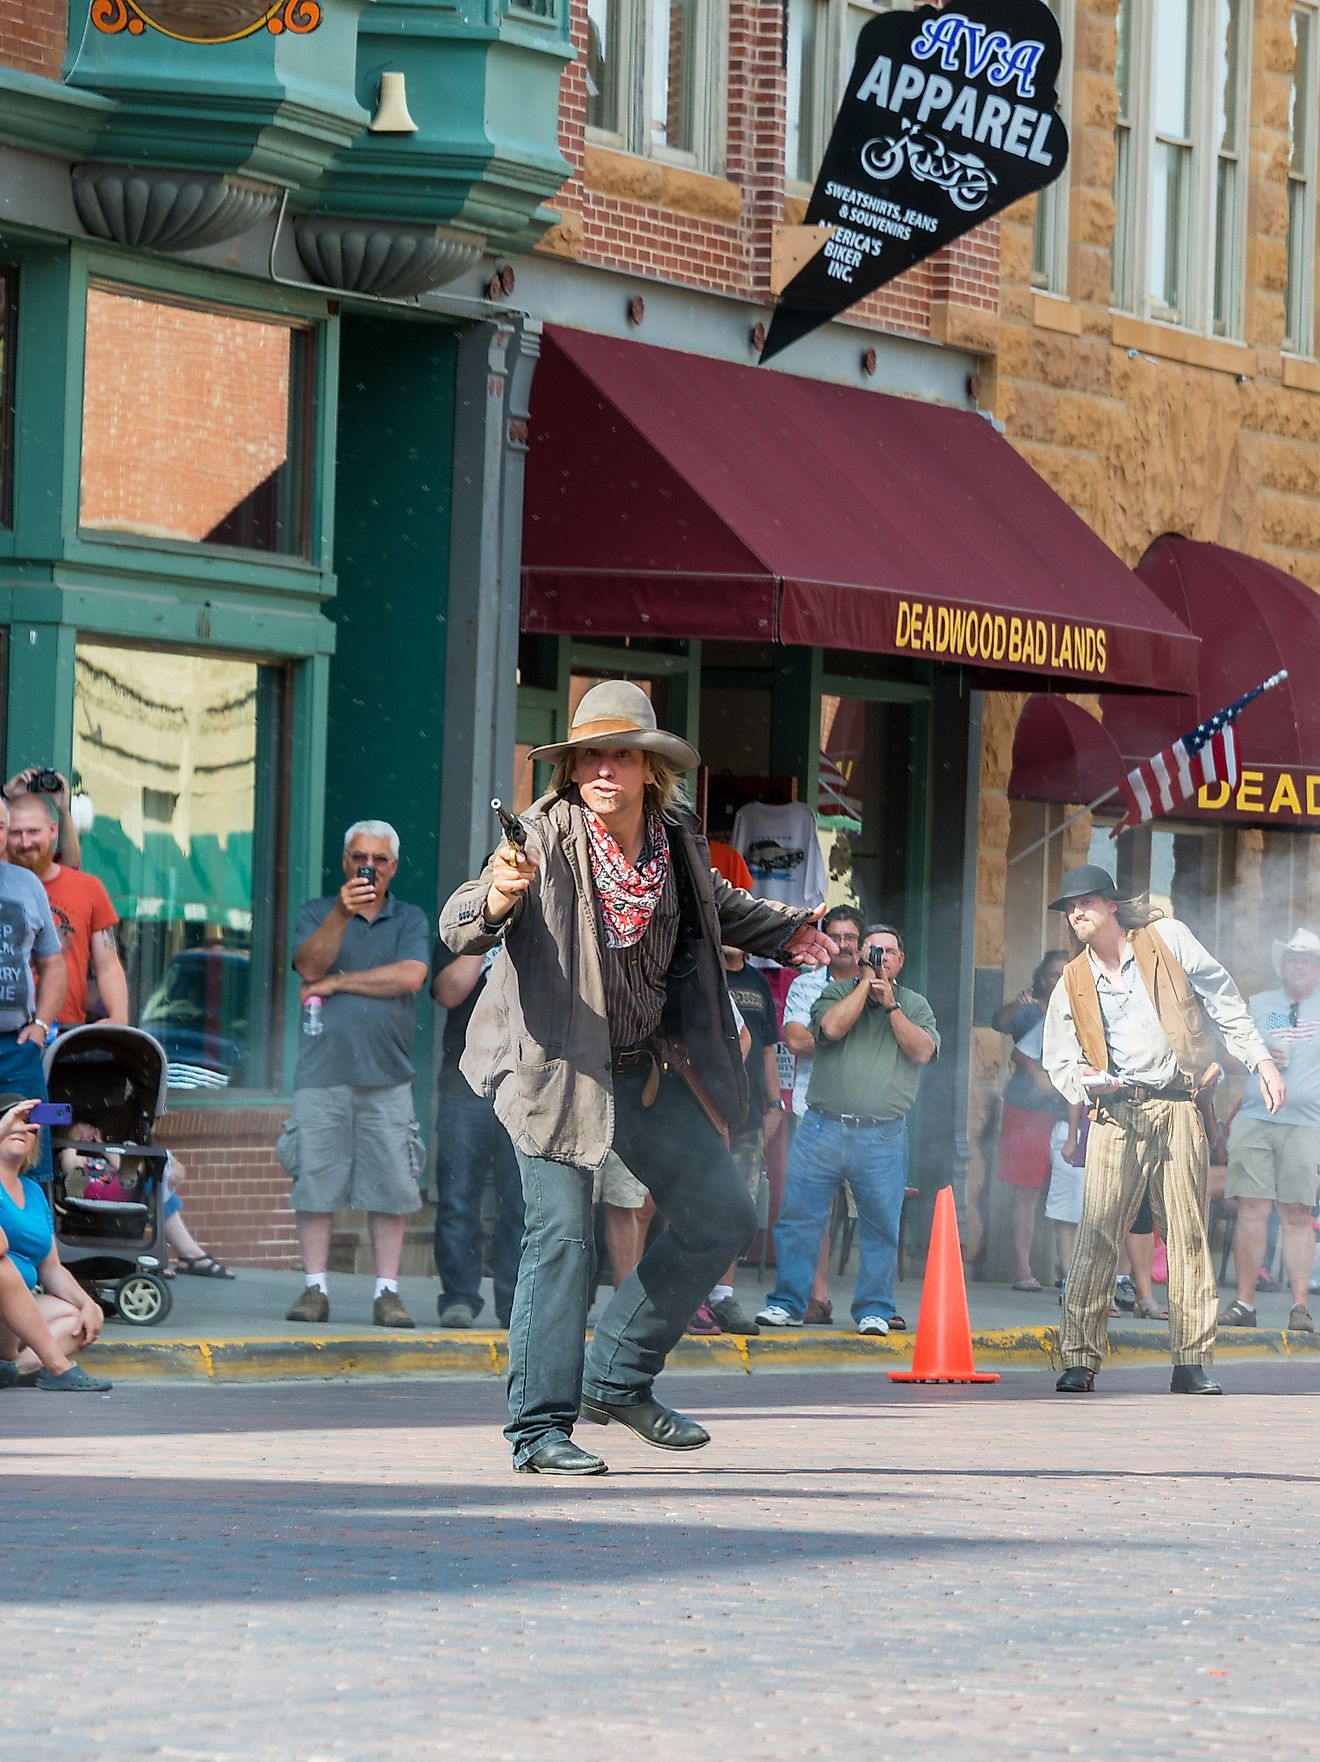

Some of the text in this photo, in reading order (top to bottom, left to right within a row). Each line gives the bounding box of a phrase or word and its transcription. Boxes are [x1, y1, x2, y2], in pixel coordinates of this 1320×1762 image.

[911, 13, 1046, 98] AVA
[856, 55, 1053, 167] APPAREL
[824, 180, 939, 233] SWEATSHIRTS, JEANS
[838, 203, 912, 240] & SOUVENIRS
[823, 240, 863, 268] BIKER
[827, 261, 853, 283] INC.
[895, 600, 1107, 675] DEADWOOD BAD LANDS
